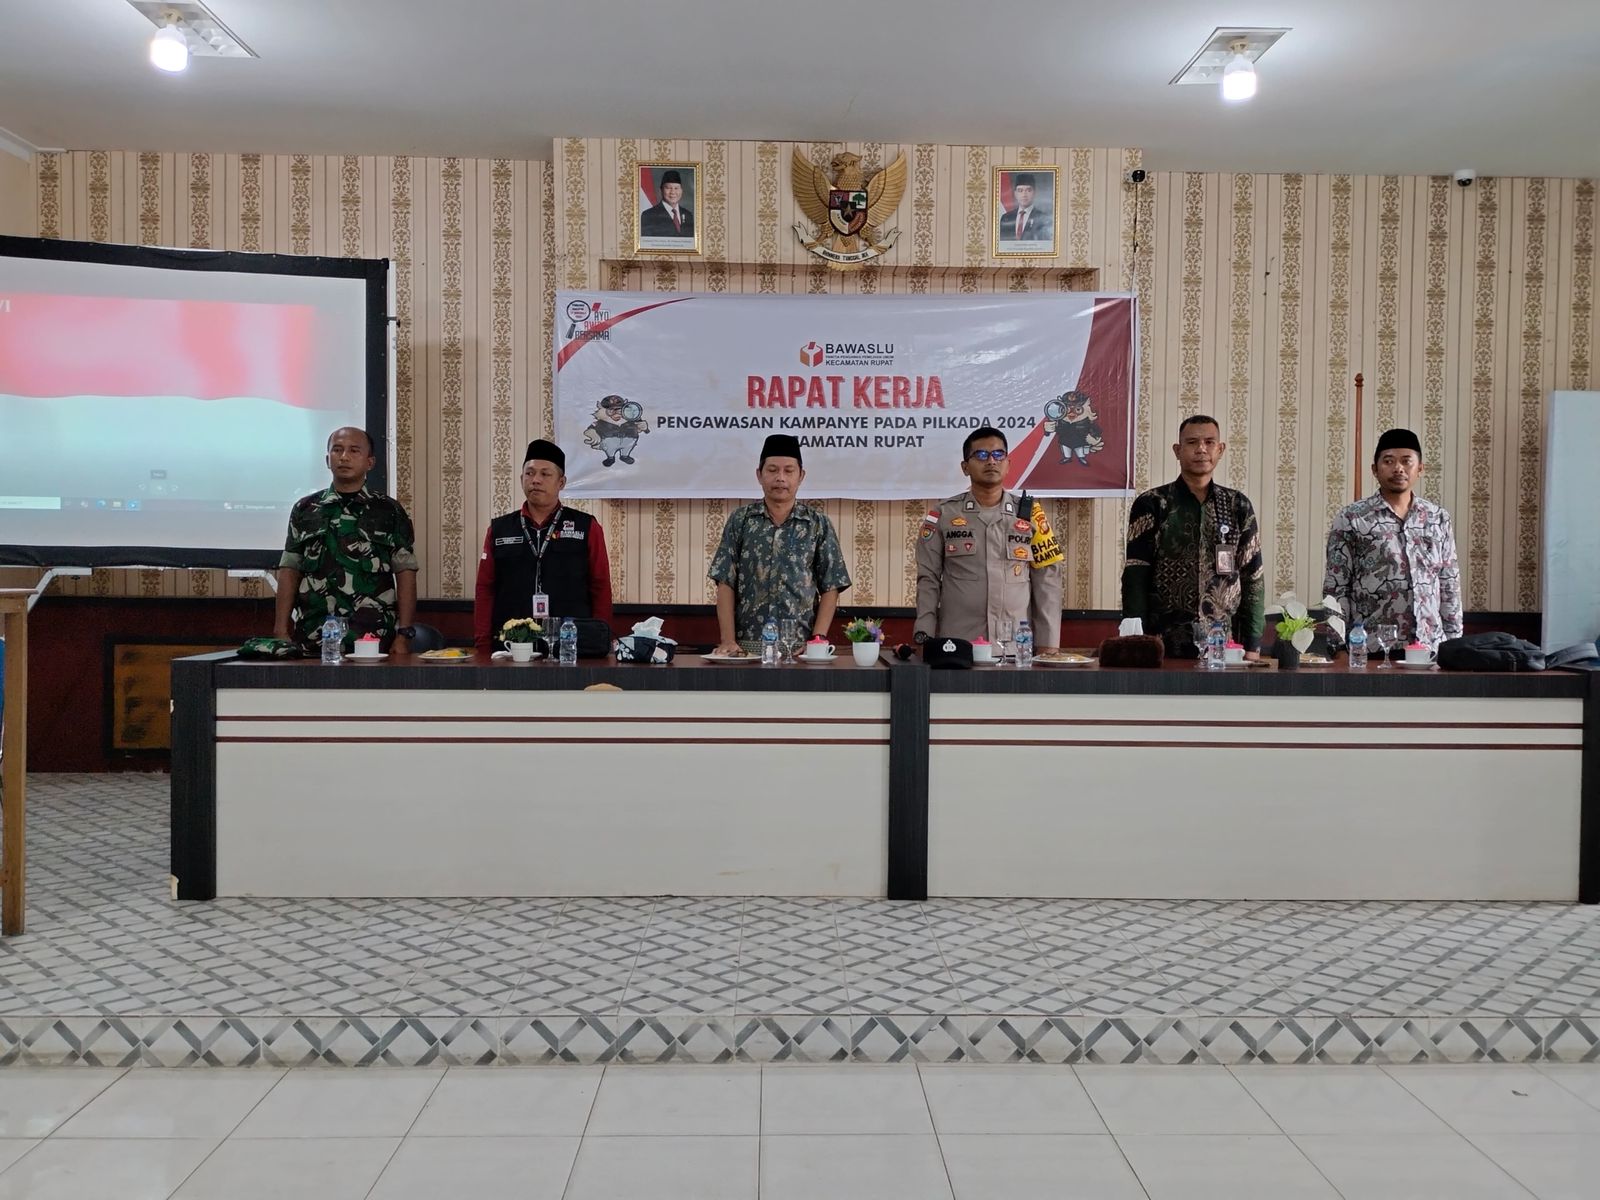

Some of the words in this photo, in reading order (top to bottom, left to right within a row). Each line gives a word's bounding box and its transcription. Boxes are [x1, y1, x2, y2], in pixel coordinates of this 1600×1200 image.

[594, 311, 609, 321] AYO
[825, 343, 894, 354] BAWASLU
[747, 375, 846, 409] RAPAT
[853, 375, 946, 409] KERJA
[656, 416, 774, 429] PENGAWASAN
[779, 416, 868, 429] KAMPANYE
[873, 416, 917, 429] PADA
[922, 416, 991, 429] PILKADA
[997, 416, 1036, 429] 2024
[799, 435, 868, 448] AMATAN
[874, 435, 924, 448] RUPAT
[946, 530, 973, 539] ANGGA
[1031, 536, 1059, 555] BHAB
